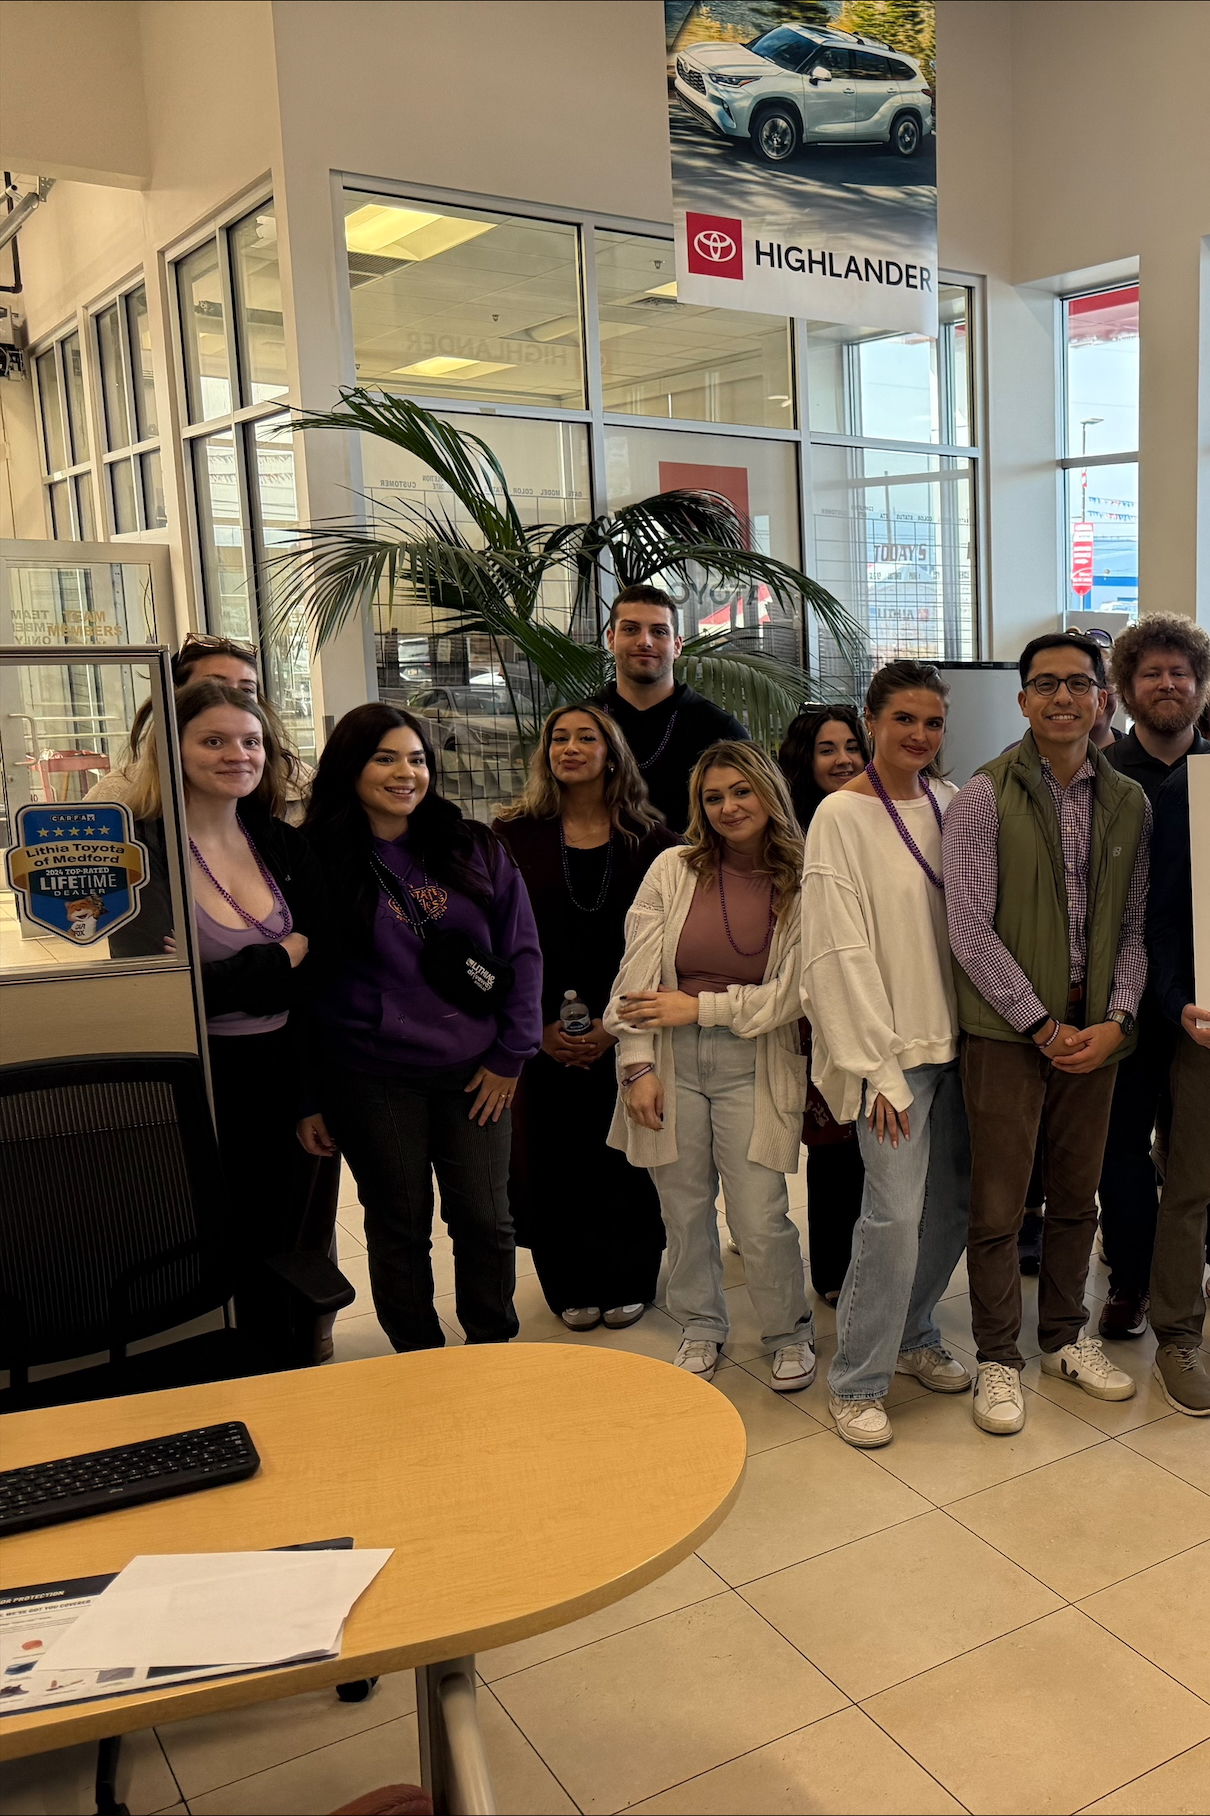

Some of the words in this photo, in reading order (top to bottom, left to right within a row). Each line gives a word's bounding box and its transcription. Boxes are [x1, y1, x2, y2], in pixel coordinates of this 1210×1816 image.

[755, 239, 933, 292] HIGHLANDER
[65, 610, 106, 623] TEAM
[47, 625, 123, 637] MEMBERS
[51, 814, 95, 822] CARFAX
[26, 845, 69, 858] Lithia
[72, 843, 125, 854] Toyota
[34, 856, 52, 867] of
[53, 854, 120, 865] Medford
[45, 869, 63, 877] 2024
[65, 867, 110, 875] TOP-RATED
[40, 873, 118, 891] LIFETIME
[54, 888, 106, 897] DEALER
[13, 1590, 66, 1603] PROTECTION
